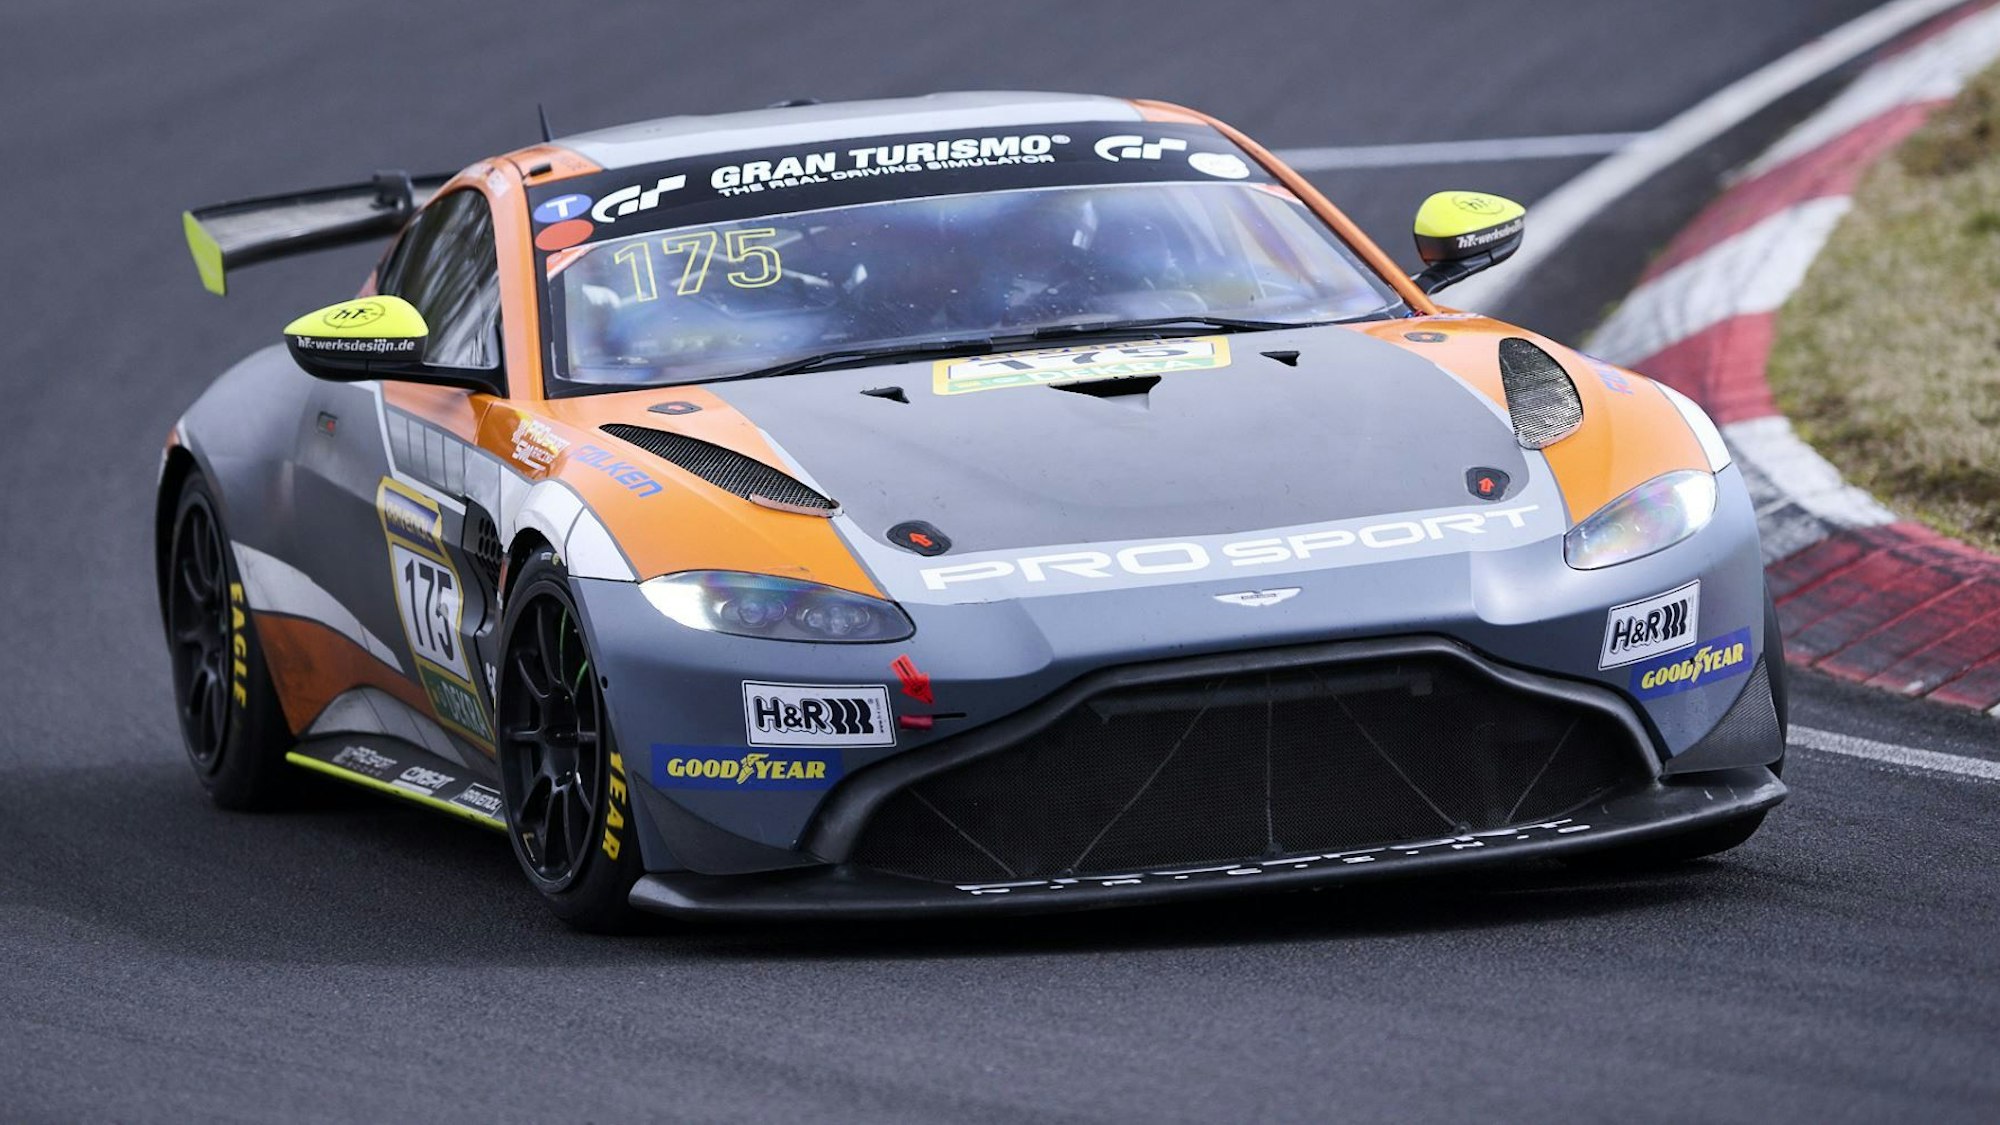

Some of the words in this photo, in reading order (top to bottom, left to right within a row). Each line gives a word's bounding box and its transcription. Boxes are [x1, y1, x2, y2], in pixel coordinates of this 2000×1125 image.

[711, 152, 836, 189] GRAN
[718, 183, 765, 198] THE
[768, 175, 829, 190] REAL
[831, 163, 923, 181] DRIVING
[926, 154, 1055, 171] SIMULATOR
[614, 227, 783, 303] 175
[978, 346, 1188, 370] 175
[1027, 360, 1197, 382] DEKRA
[919, 541, 1210, 591] PRO
[1224, 504, 1540, 568] SPORT
[405, 558, 454, 661] 175
[1610, 609, 1663, 654] H&R
[230, 582, 247, 709] EAGLE
[754, 697, 832, 733] H&R
[602, 752, 627, 860] YEAR
